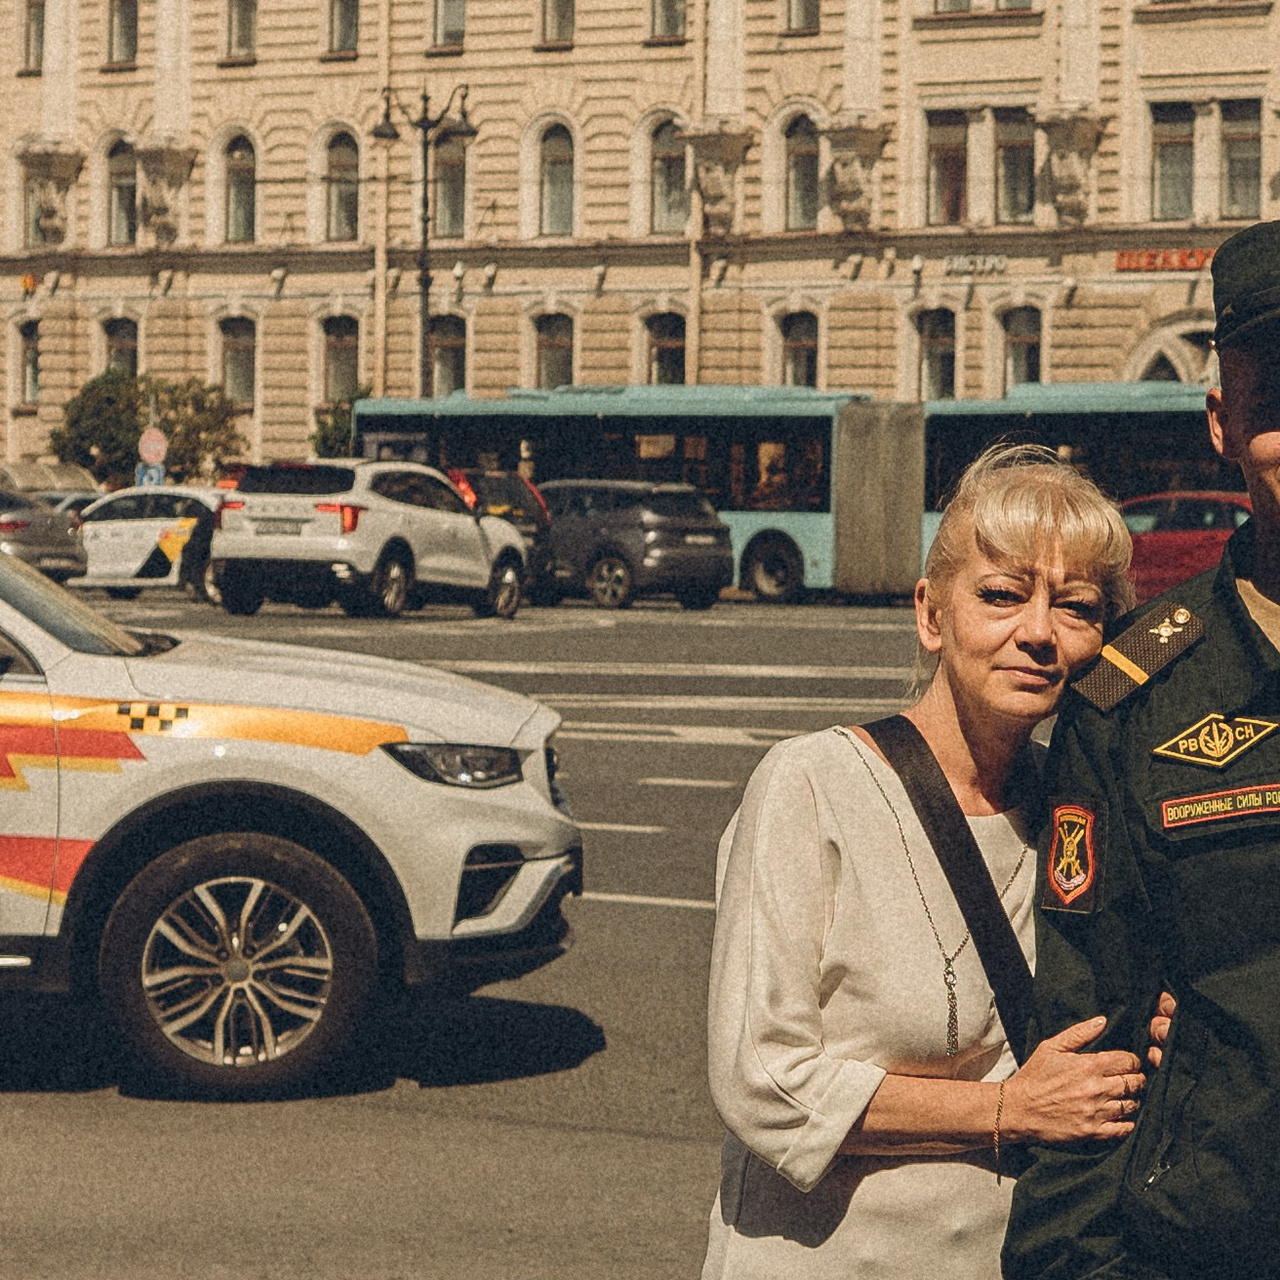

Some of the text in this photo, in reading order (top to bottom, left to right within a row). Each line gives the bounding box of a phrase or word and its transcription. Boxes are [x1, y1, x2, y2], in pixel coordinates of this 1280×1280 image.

[1178, 723, 1255, 753] РВ СН
[1166, 797, 1234, 821] ВООРУЖЕННЫЕ
[1236, 793, 1263, 810] СИЛЫ
